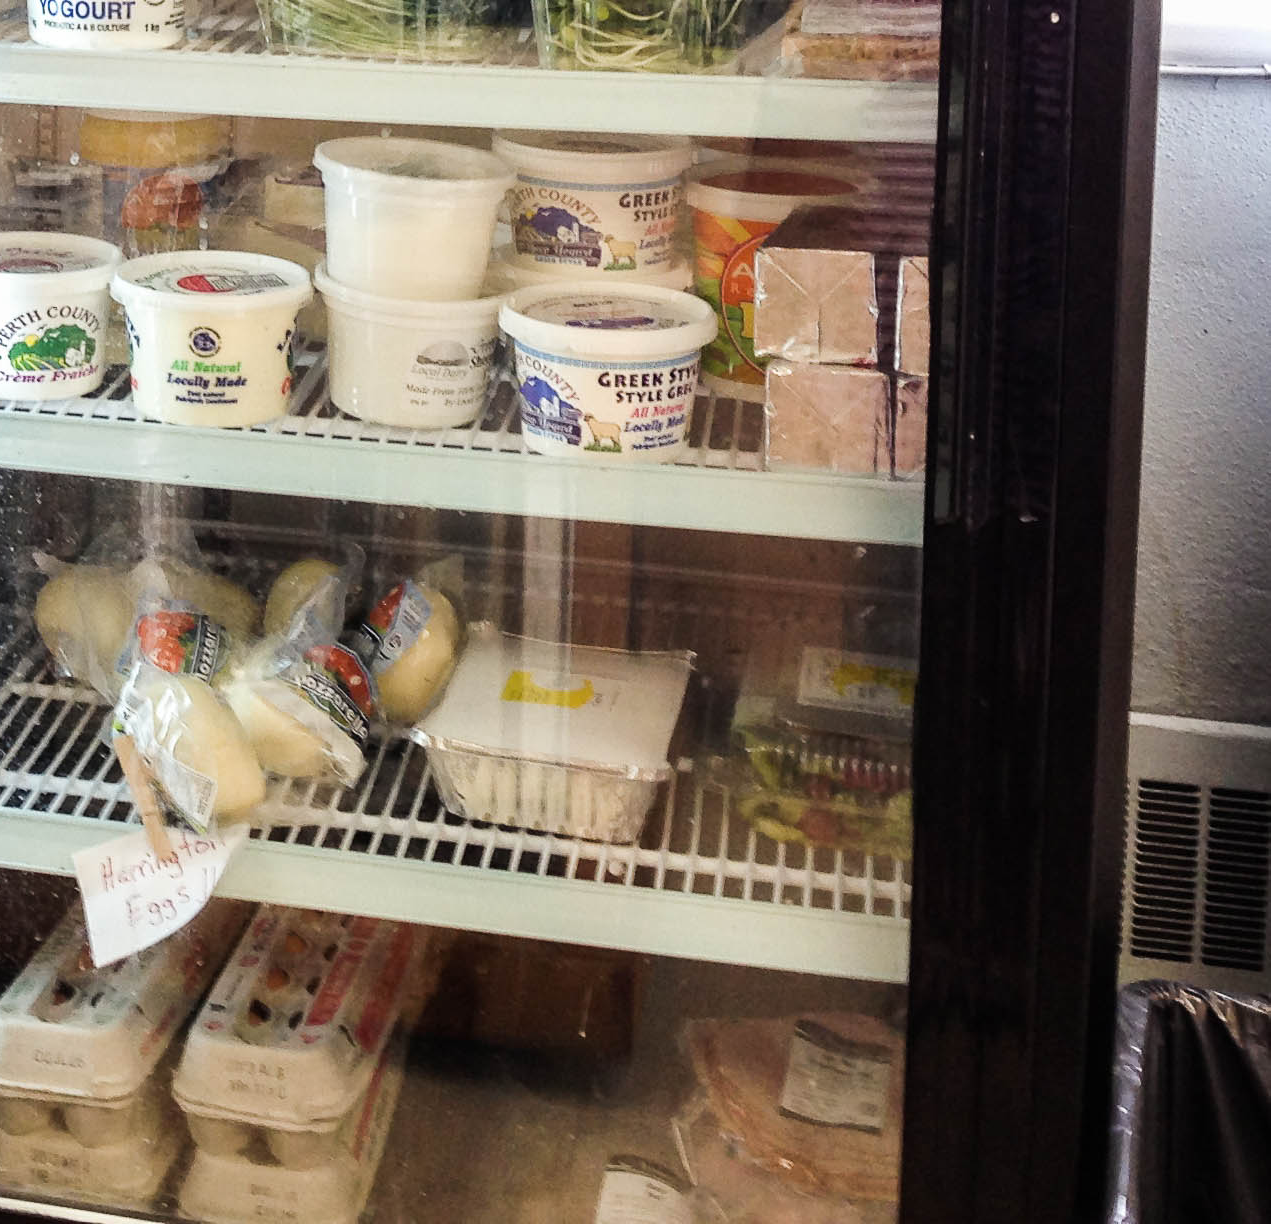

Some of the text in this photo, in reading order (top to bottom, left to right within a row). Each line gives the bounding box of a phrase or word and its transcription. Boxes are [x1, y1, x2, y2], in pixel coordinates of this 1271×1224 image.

[97, 23, 131, 32] CULTURE
[619, 190, 669, 209] GREEK
[46, 305, 101, 333] COUNTY
[193, 361, 242, 373] Natural
[166, 373, 249, 390] Locally Made
[524, 354, 581, 402] COUNTY
[597, 371, 665, 389] GREEK
[615, 389, 663, 404] STYLE
[631, 406, 650, 419] All
[623, 418, 664, 433] Locally
[126, 885, 190, 927] Eggs
